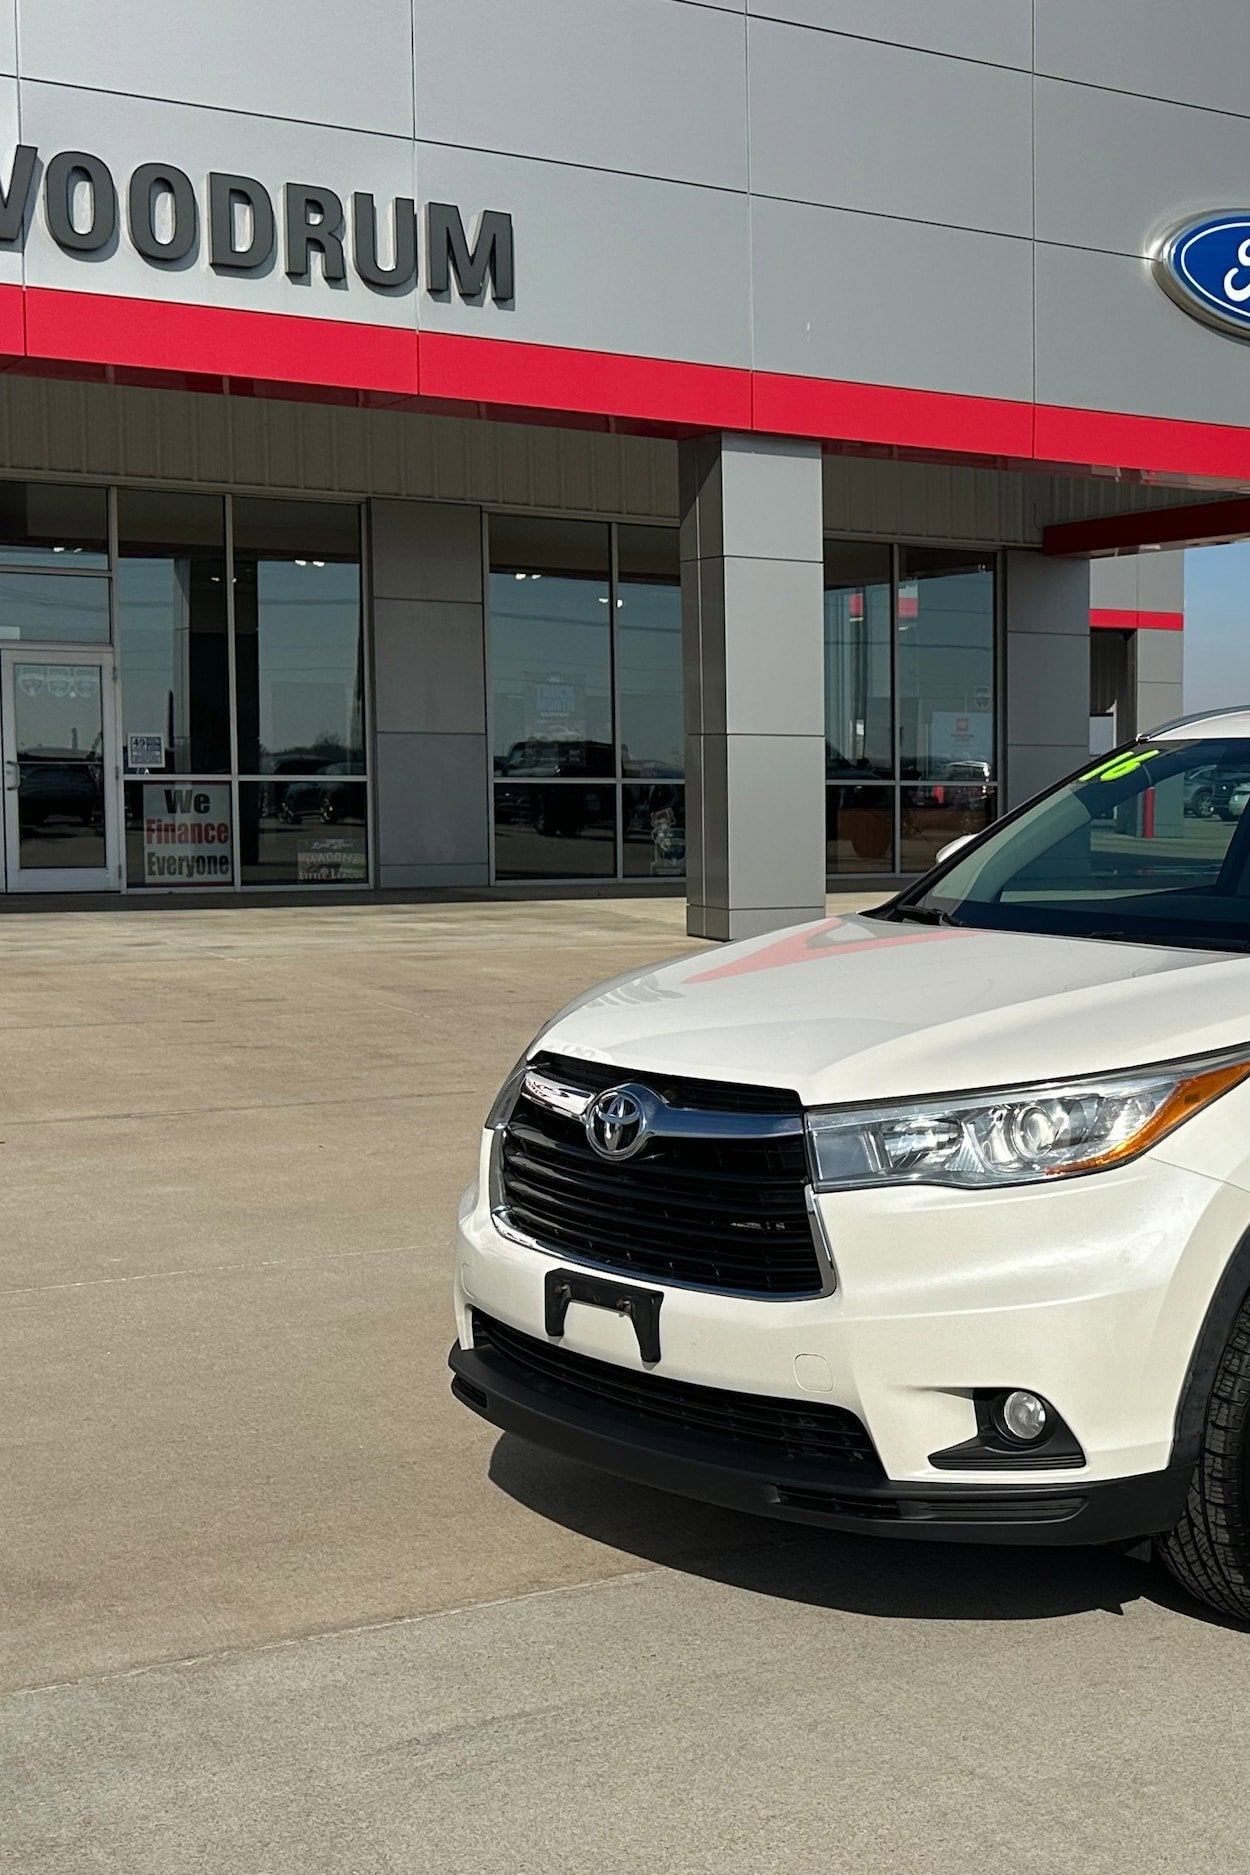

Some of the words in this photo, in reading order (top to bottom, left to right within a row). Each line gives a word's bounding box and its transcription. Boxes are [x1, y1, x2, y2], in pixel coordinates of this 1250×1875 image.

[1078, 749, 1160, 782] 16
[164, 789, 211, 814] We
[145, 818, 229, 844] Finance
[147, 852, 230, 878] Everyone
